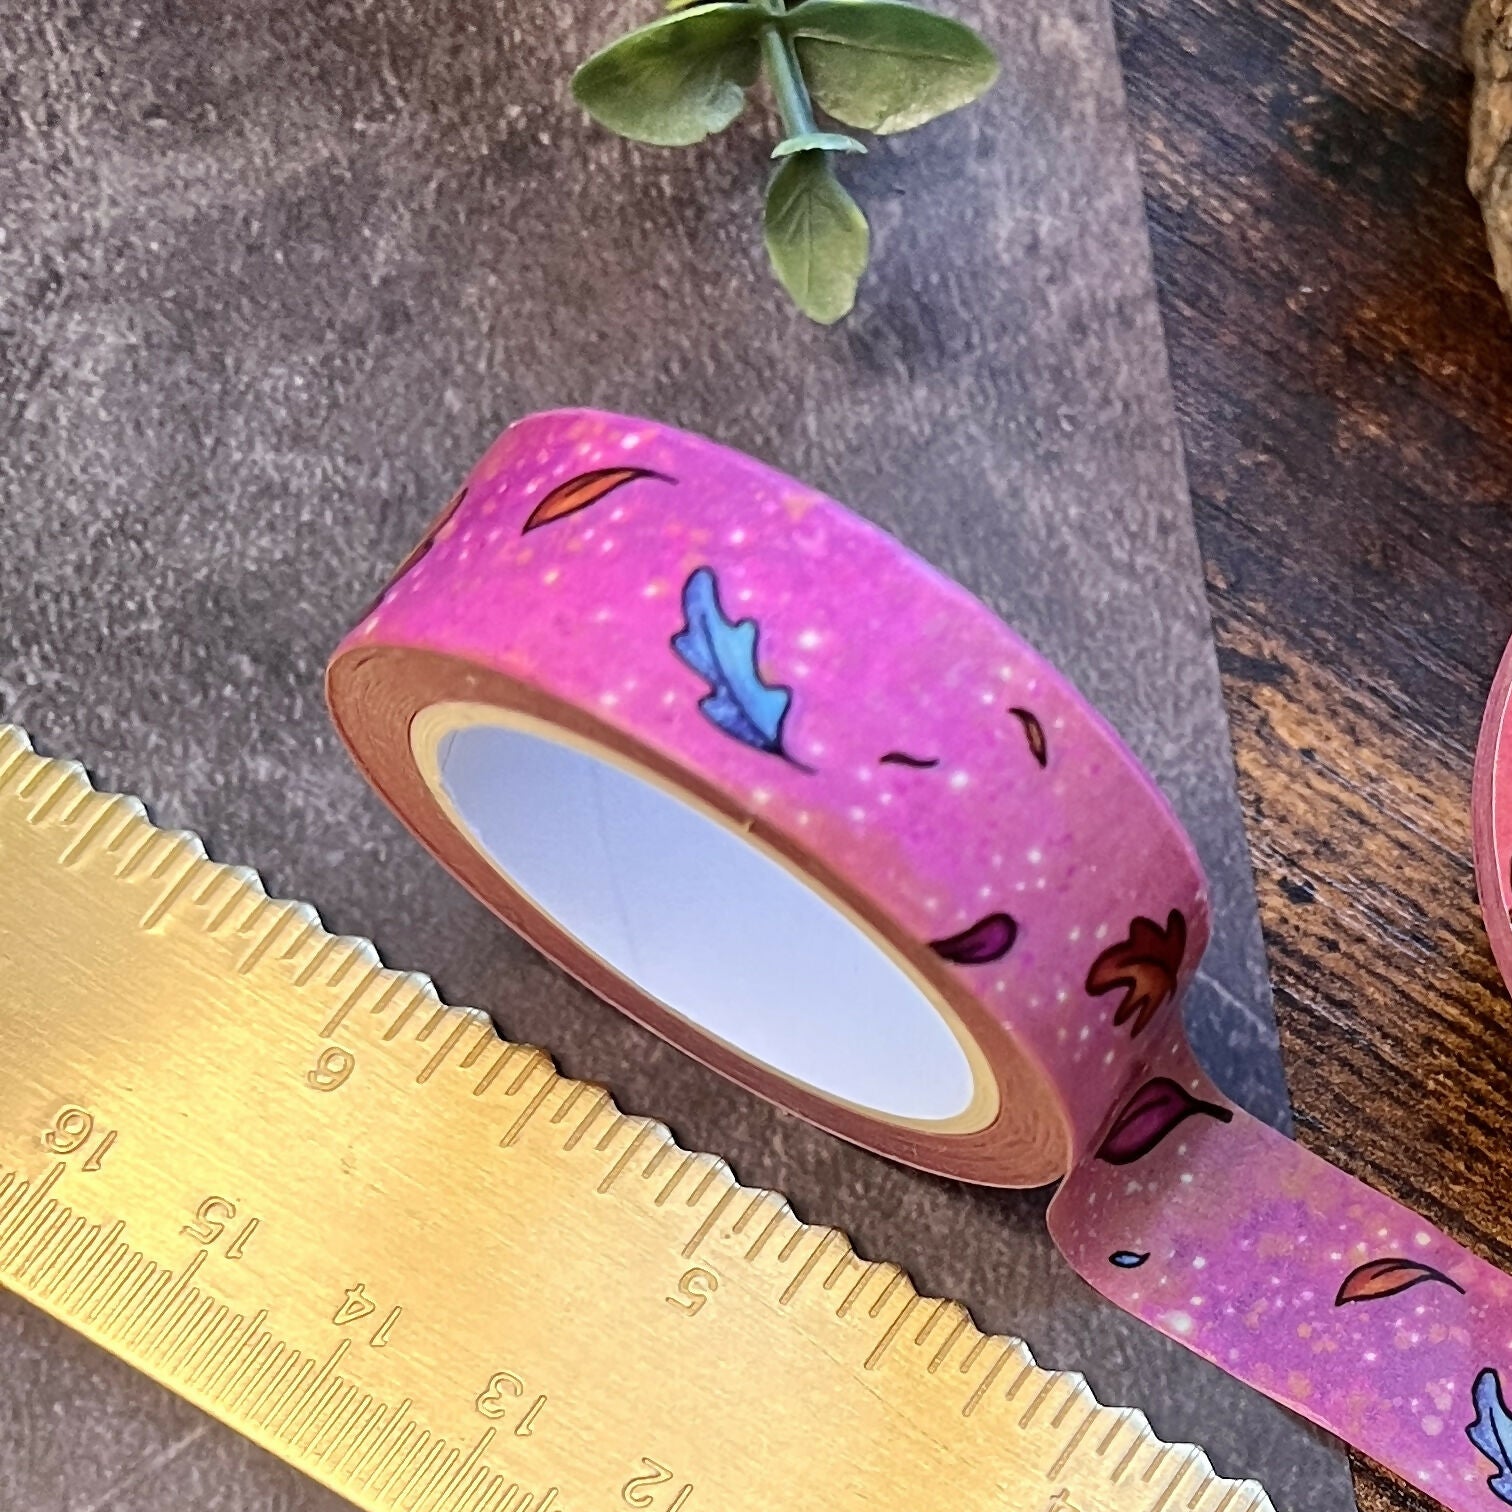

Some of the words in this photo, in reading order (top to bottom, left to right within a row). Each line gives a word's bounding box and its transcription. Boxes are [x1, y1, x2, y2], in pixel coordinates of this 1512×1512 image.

[307, 1047, 355, 1093] 6
[41, 1103, 118, 1172] 16
[179, 1197, 259, 1259] 15
[333, 1283, 402, 1347] 14
[666, 1267, 719, 1316] 5
[475, 1372, 547, 1436] 13
